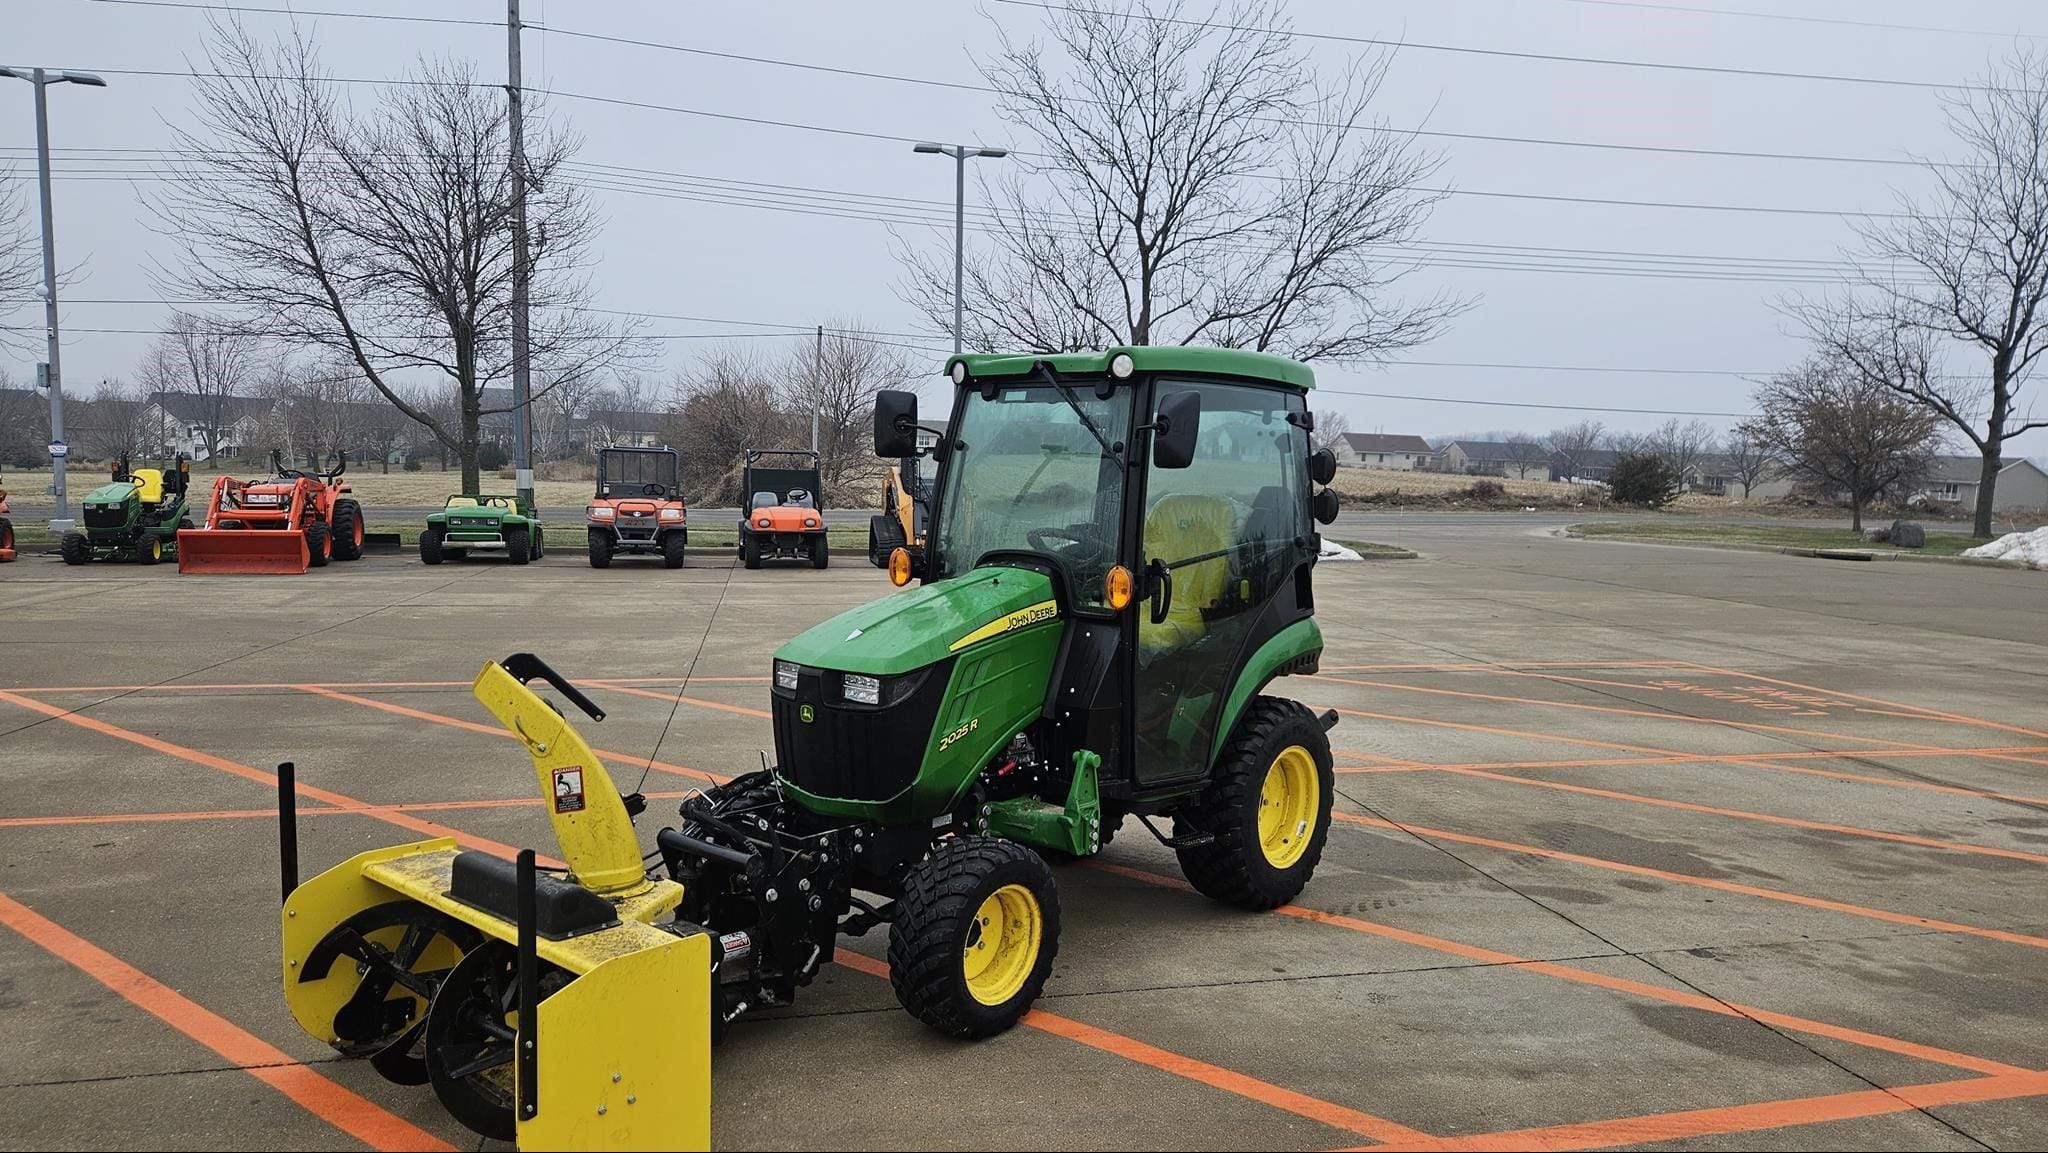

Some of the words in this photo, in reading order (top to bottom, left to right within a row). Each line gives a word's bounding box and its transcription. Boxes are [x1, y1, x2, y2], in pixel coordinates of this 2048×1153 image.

[1007, 614, 1029, 630] JOHN
[1030, 606, 1055, 621] DEERE
[939, 723, 969, 752] 2025
[970, 718, 978, 731] R
